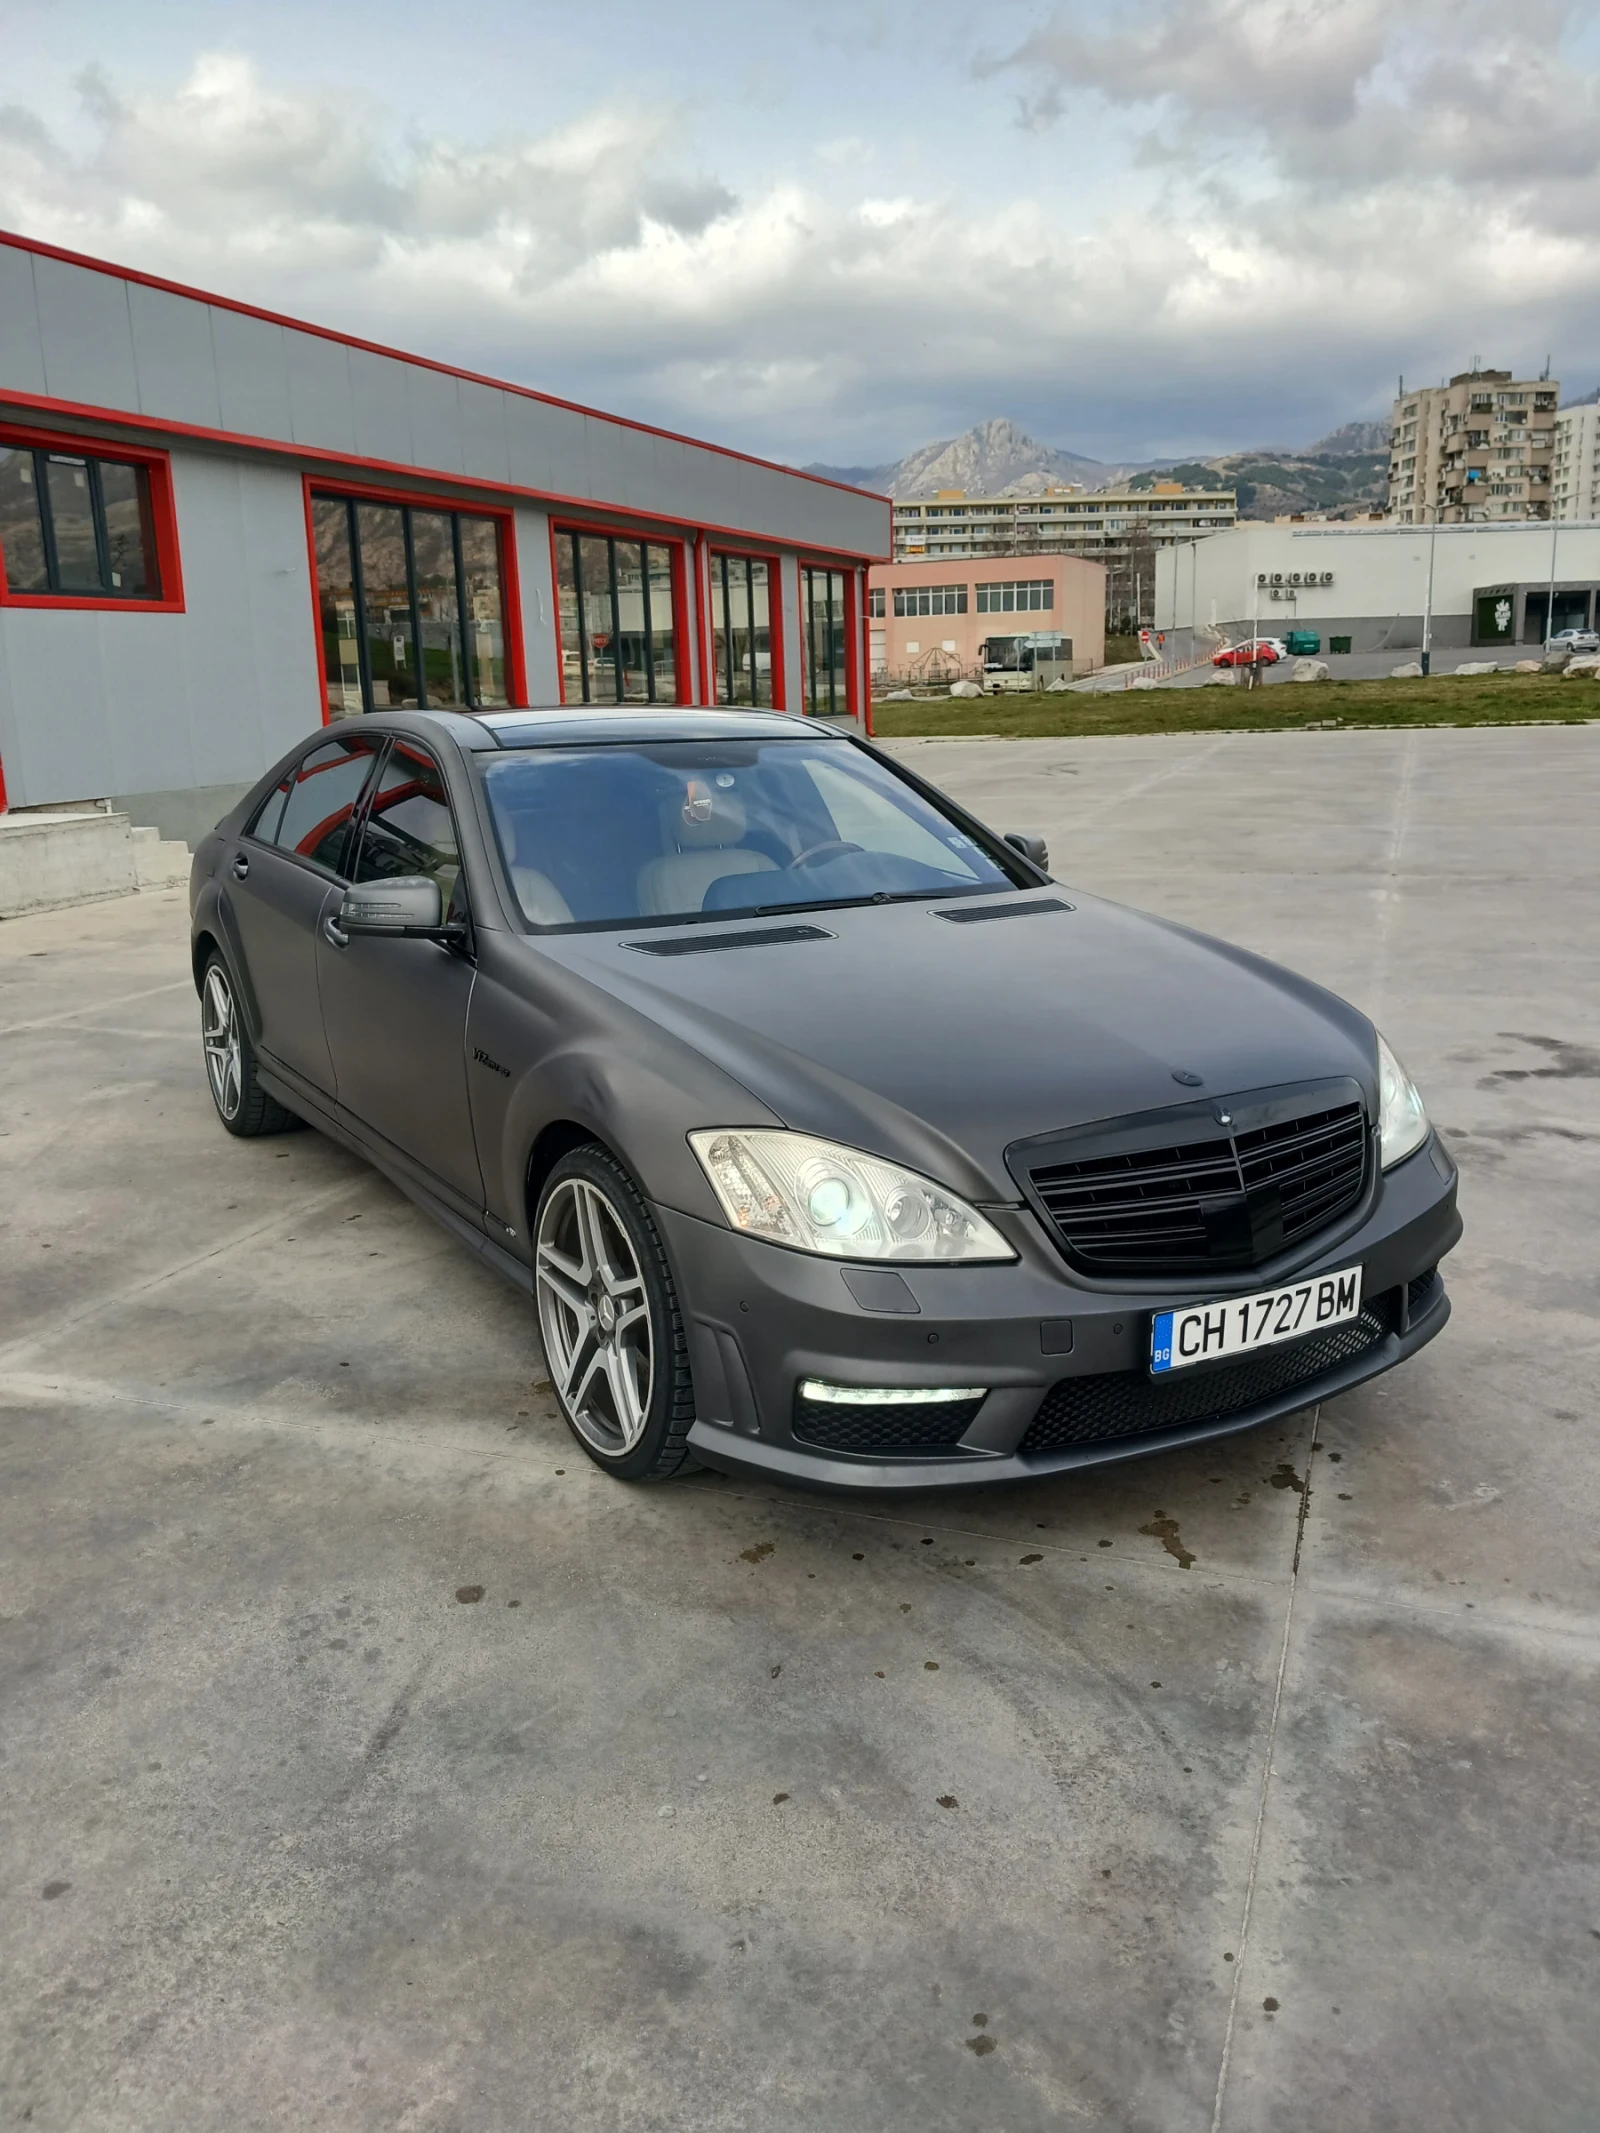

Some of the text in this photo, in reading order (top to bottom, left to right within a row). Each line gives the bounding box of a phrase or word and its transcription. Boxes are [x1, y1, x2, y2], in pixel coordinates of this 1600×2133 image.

[1179, 1273, 1357, 1357] CH 1727 BM
[1154, 1347, 1170, 1363] BG
